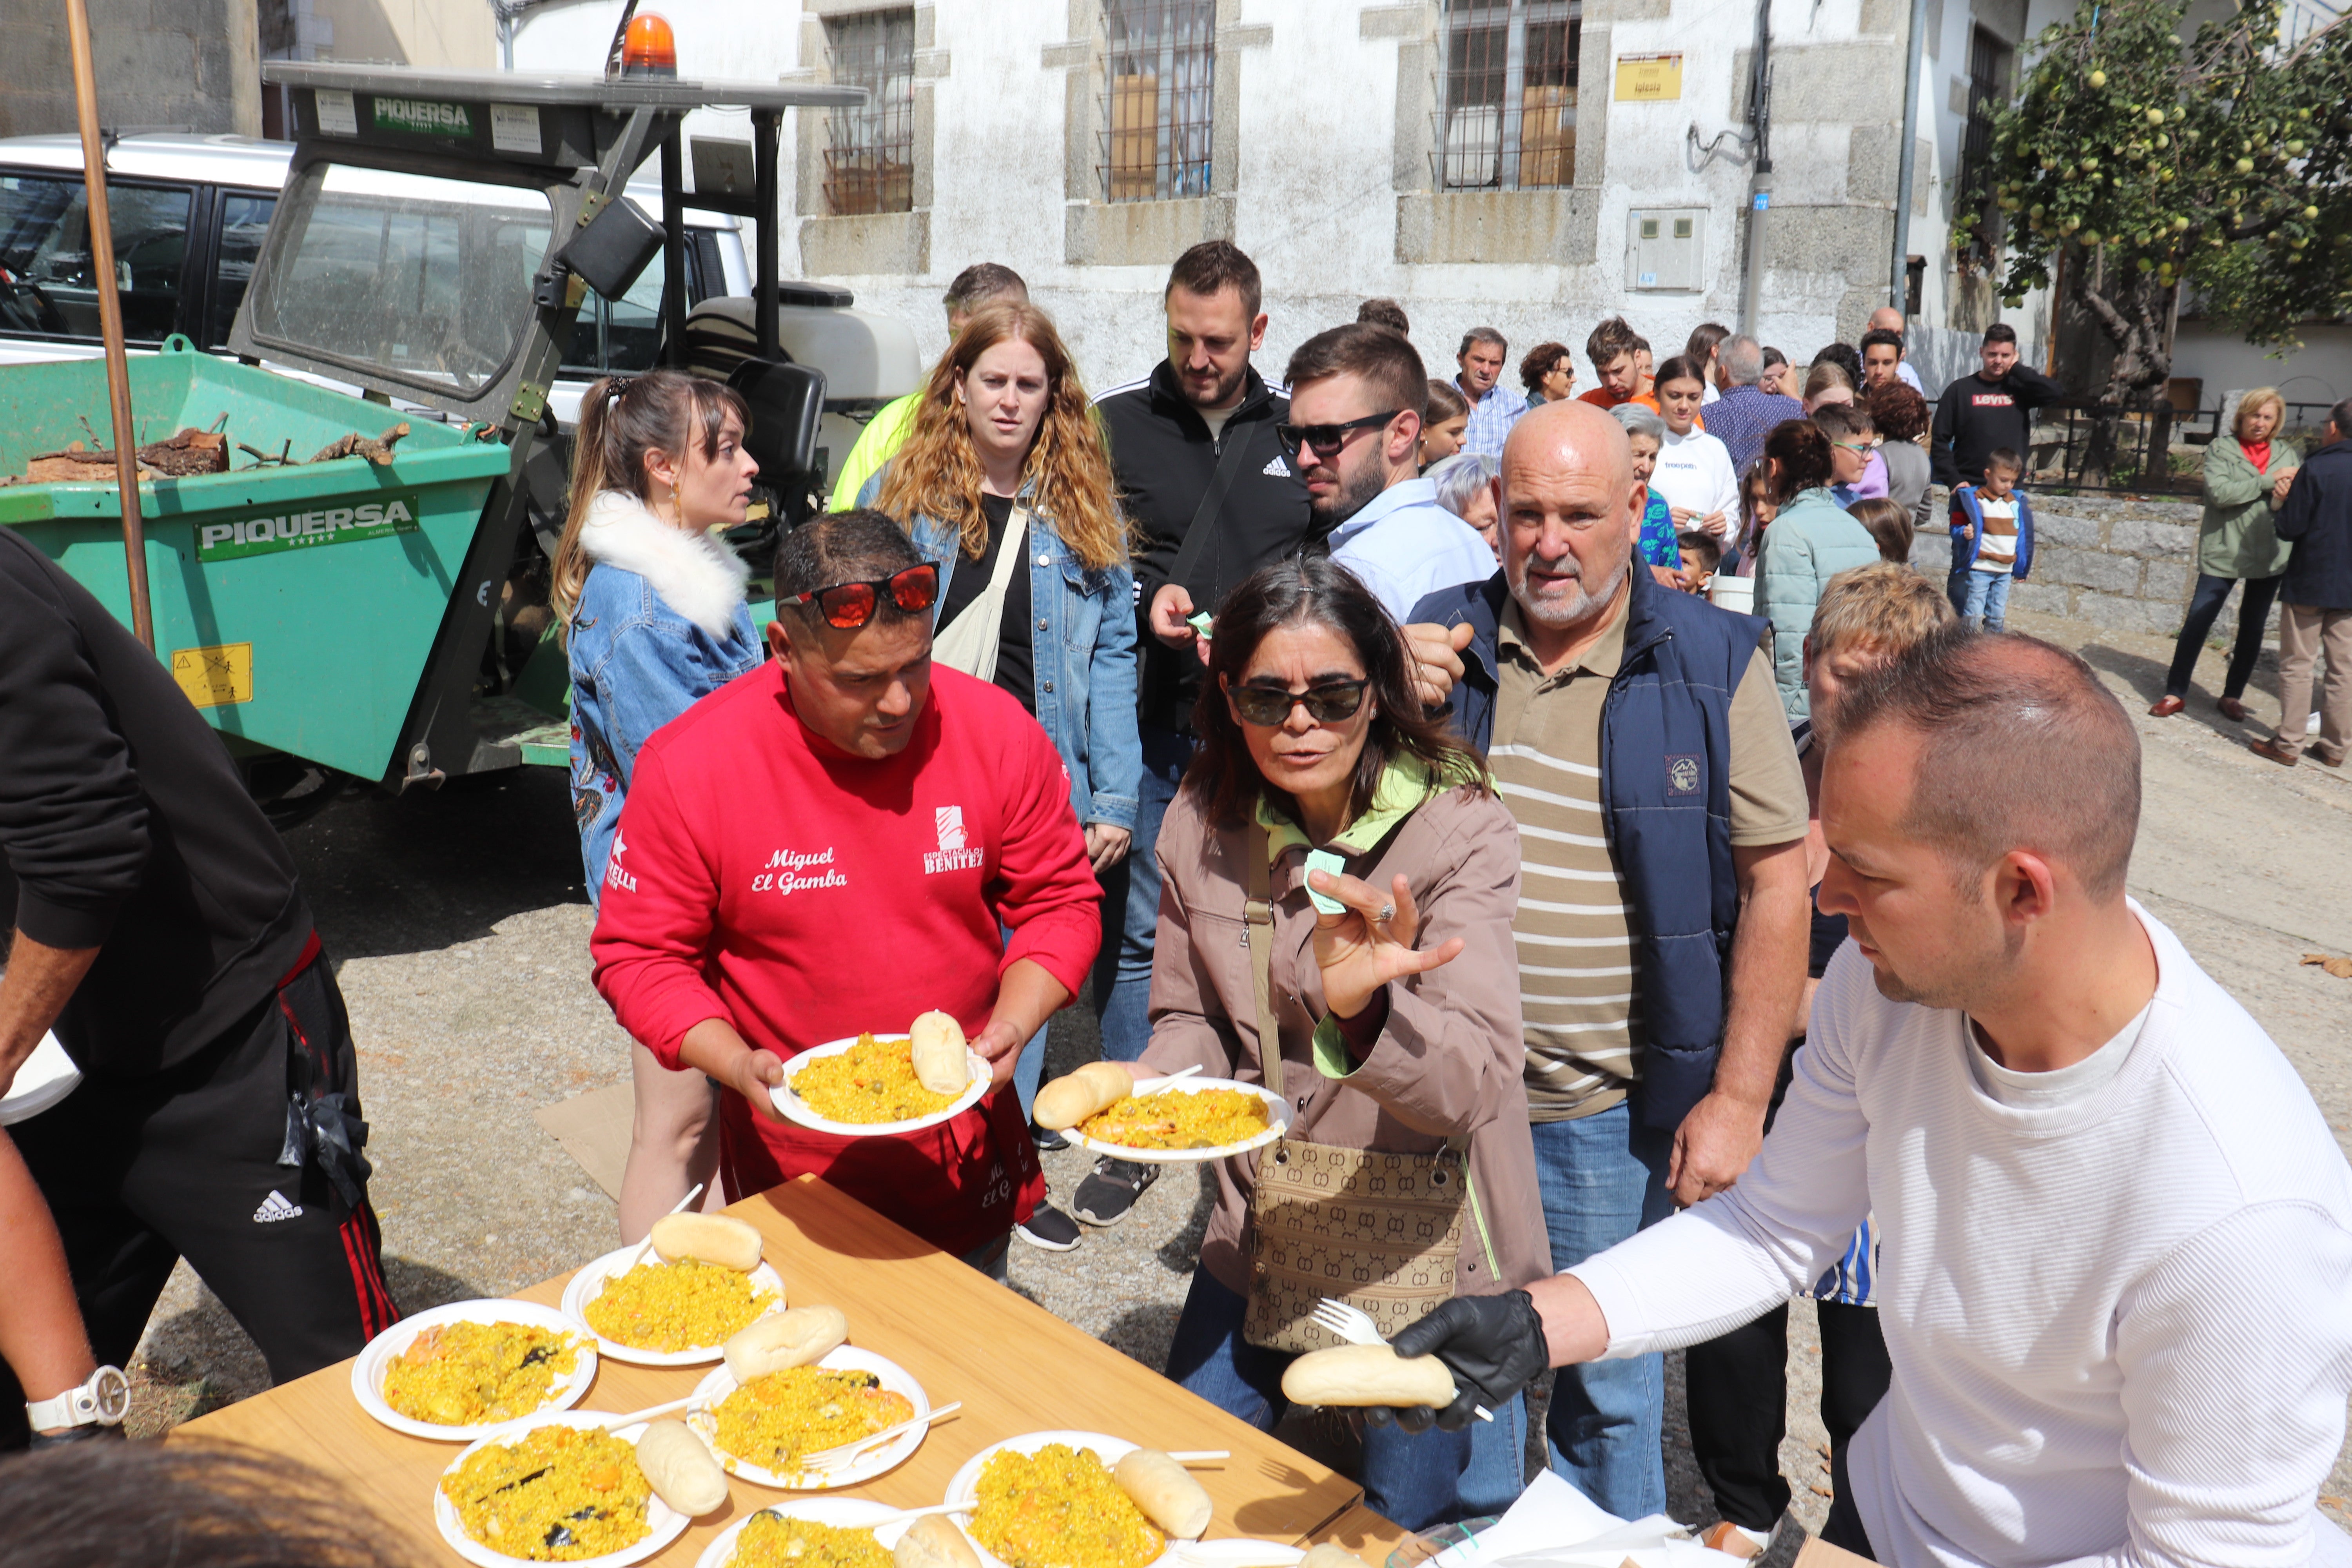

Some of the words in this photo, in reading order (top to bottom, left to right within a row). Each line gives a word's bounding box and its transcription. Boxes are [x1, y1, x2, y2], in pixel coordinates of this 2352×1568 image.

[374, 98, 469, 126] PIQUERSA
[1263, 467, 1291, 477] adidas
[201, 500, 412, 549] PIQUERSA
[765, 846, 835, 872] Miguel
[924, 847, 984, 860] ESPECTACULOS
[924, 853, 984, 875] BENITEZ
[751, 873, 773, 892] El
[778, 868, 847, 896] Gamba
[253, 1206, 303, 1223] adidas
